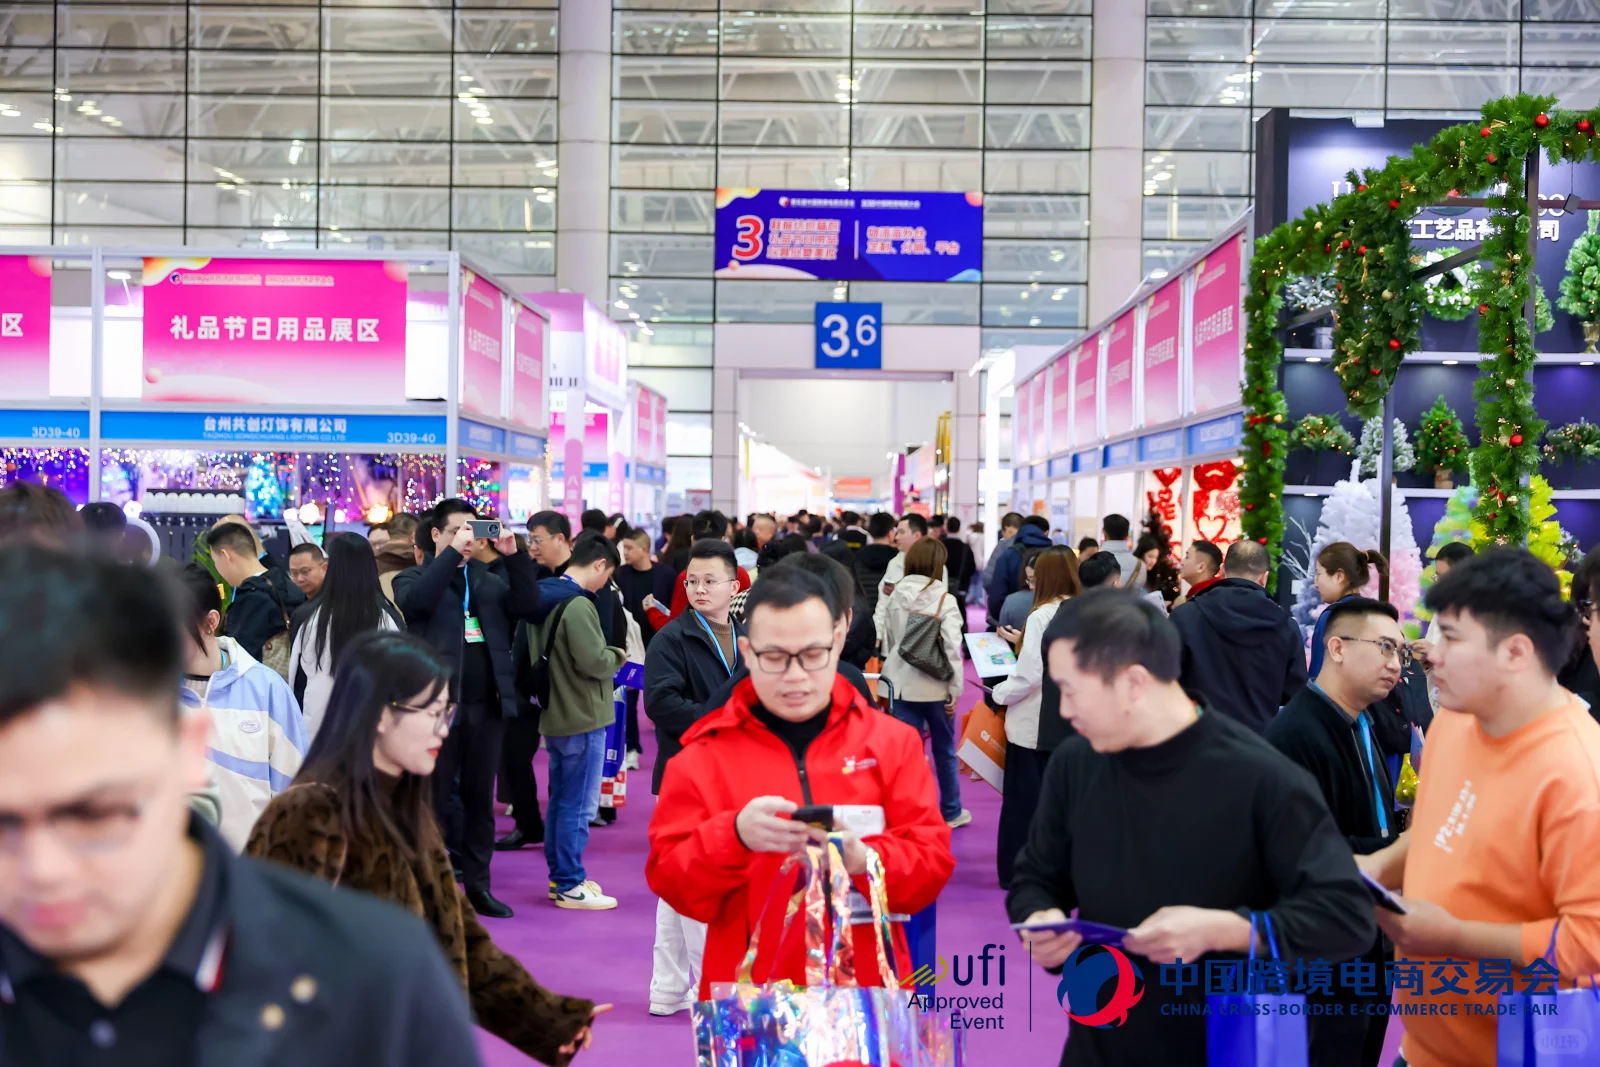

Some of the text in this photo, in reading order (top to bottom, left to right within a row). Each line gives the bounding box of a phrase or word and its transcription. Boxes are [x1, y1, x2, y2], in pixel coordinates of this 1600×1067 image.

[732, 215, 764, 261] 3
[1, 312, 24, 337] 区
[169, 314, 380, 343] 礼品节日用品展区
[821, 313, 878, 359] 3.6
[31, 426, 81, 439] 3D39-40
[204, 416, 347, 433] 台州共创灯饰有限公司
[387, 432, 437, 444] 3D39-40
